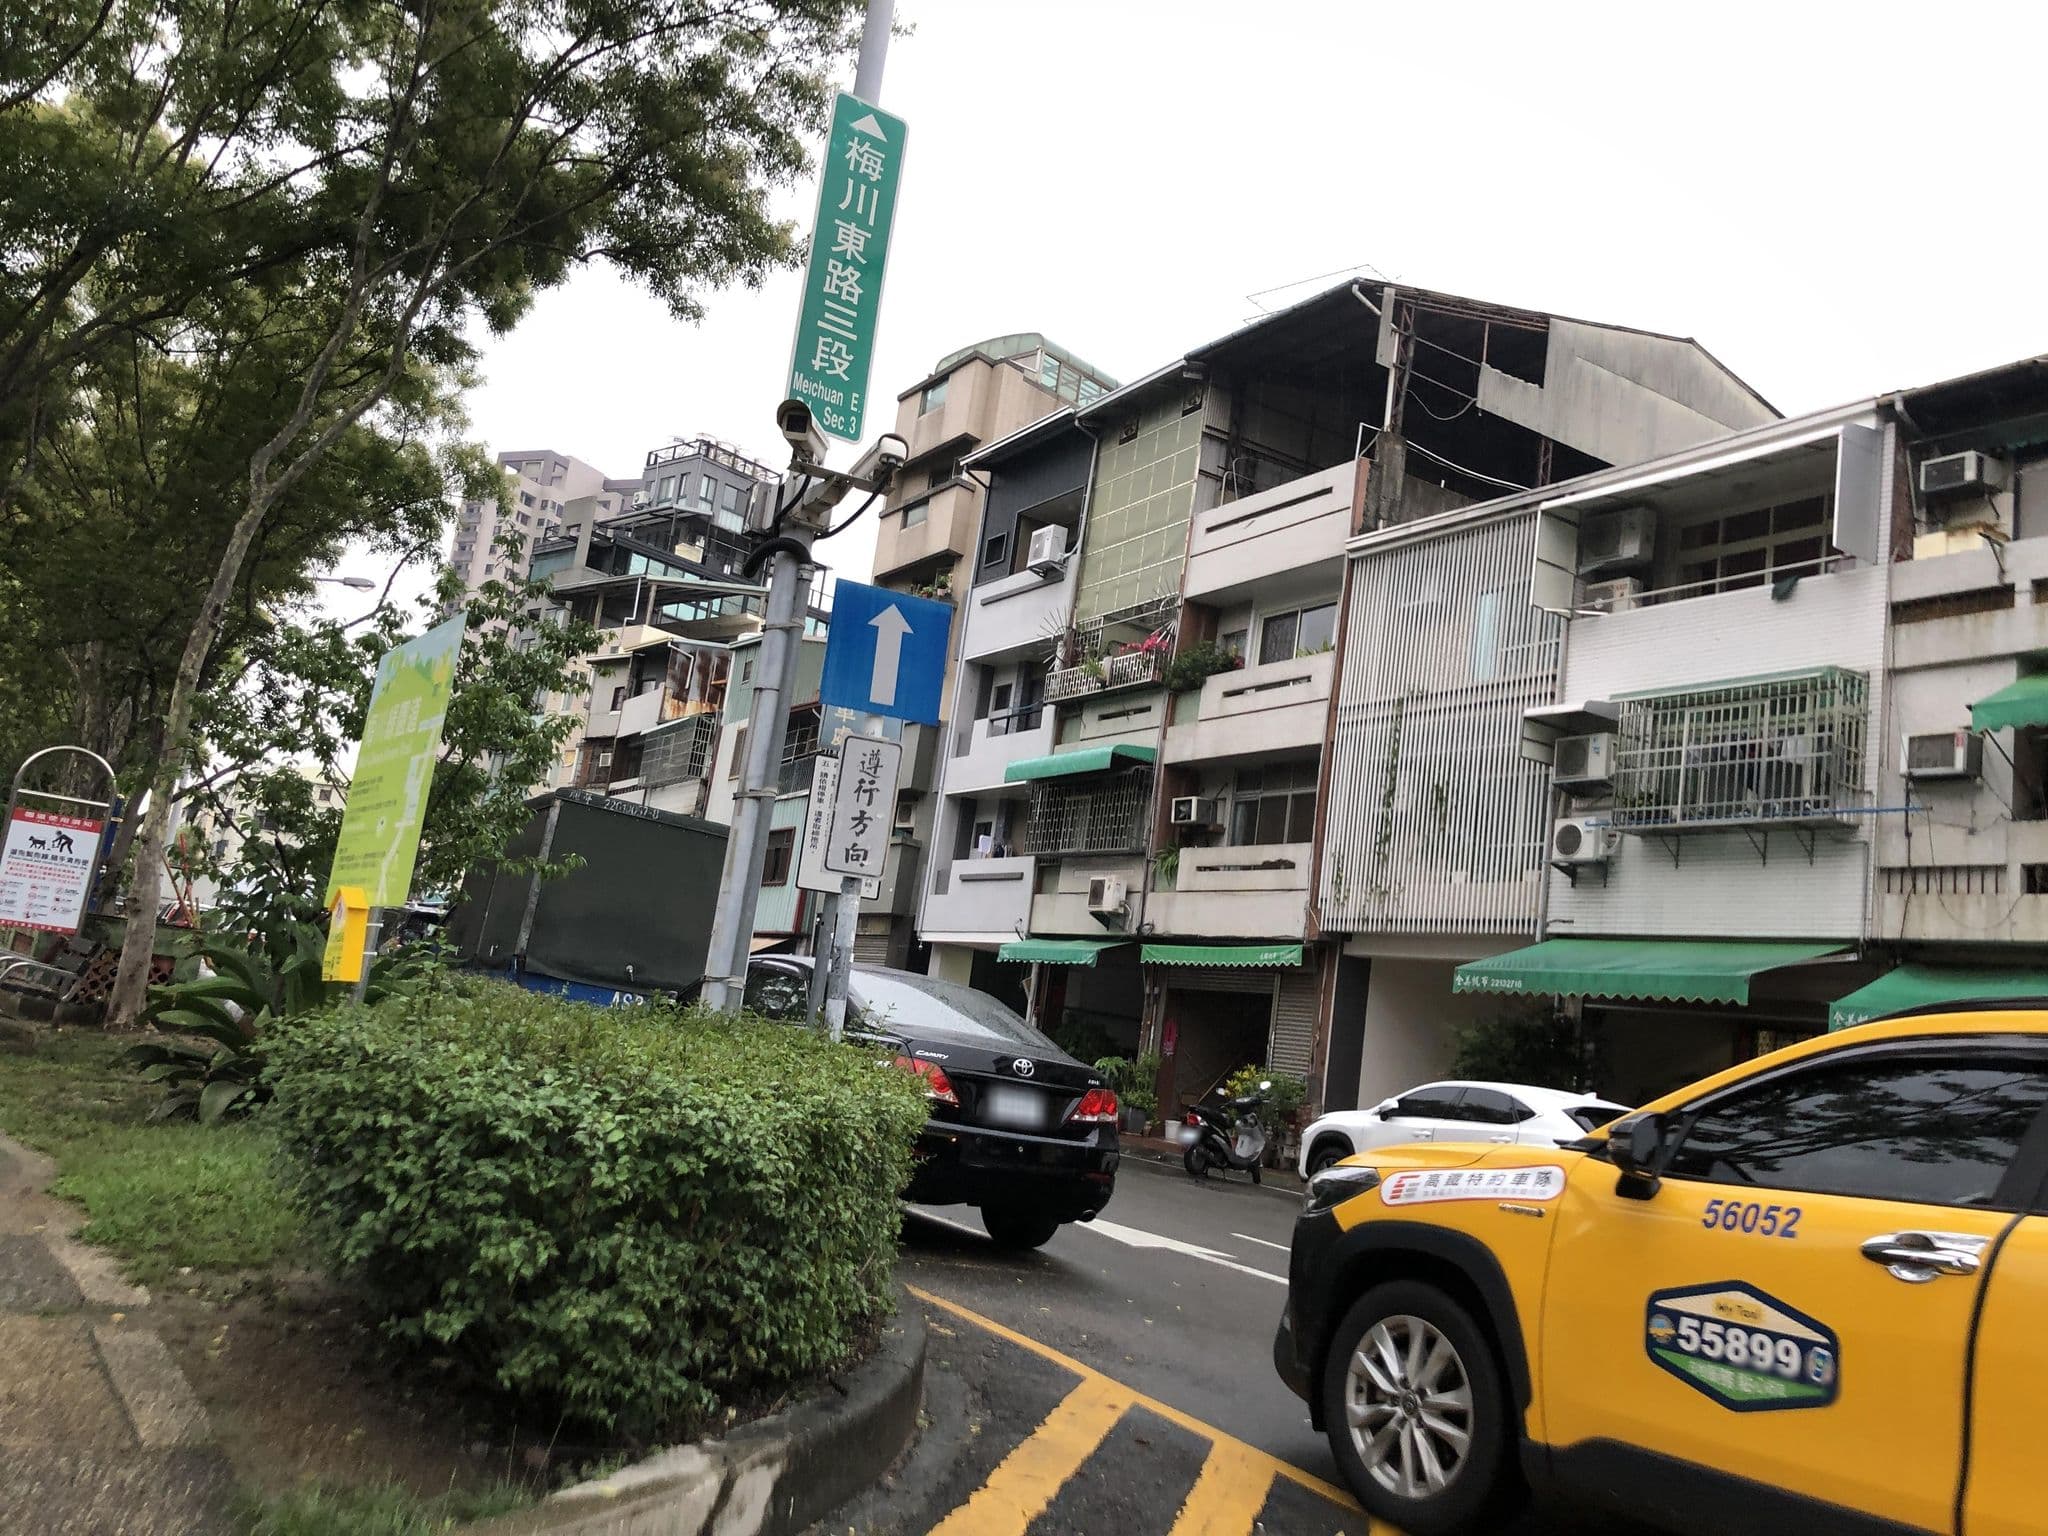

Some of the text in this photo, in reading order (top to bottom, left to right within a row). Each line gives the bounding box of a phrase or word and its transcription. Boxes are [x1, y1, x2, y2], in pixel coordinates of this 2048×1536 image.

[811, 137, 886, 382] 梅川東路三段
[793, 371, 844, 407] Meichuan
[823, 406, 857, 434] Sec. 3
[845, 750, 884, 868] 遵行方向
[1702, 1199, 1802, 1239] 56052
[1676, 1316, 1802, 1379] 55899
